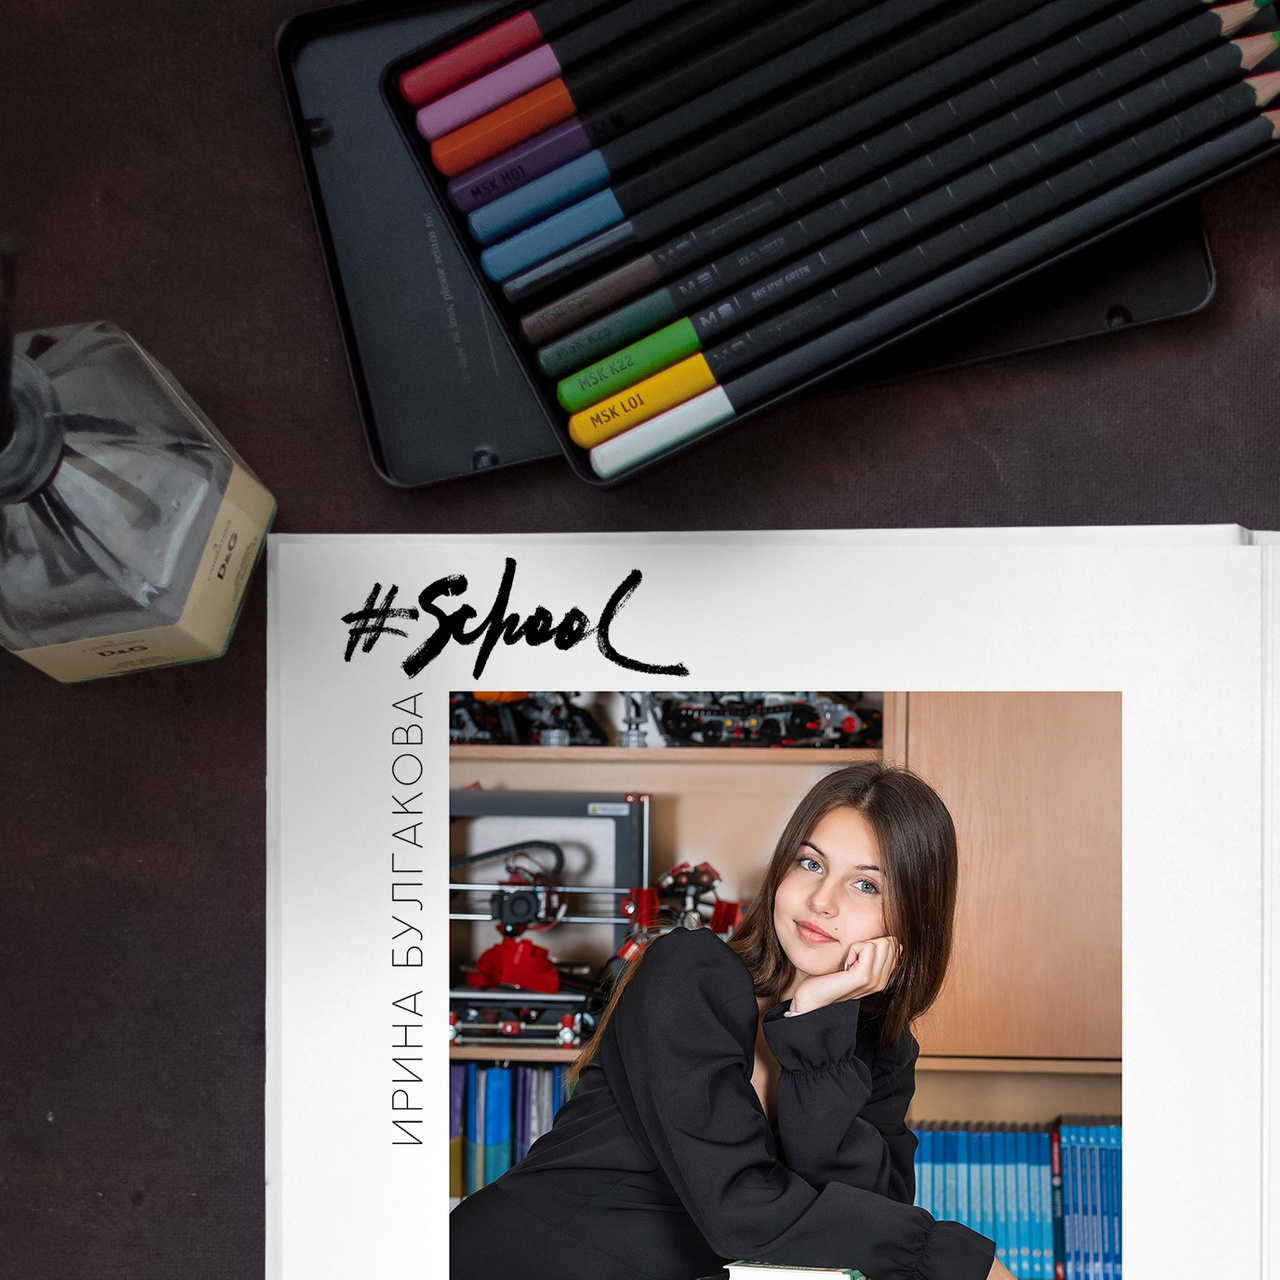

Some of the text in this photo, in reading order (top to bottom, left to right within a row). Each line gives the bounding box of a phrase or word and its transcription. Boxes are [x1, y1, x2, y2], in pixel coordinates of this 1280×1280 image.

[470, 177, 500, 201] MSK
[429, 231, 442, 263] return
[437, 268, 453, 301] please
[784, 264, 812, 285] GREEN
[578, 354, 635, 391] MSK K22
[590, 393, 645, 429] MSK L01
[216, 532, 239, 580] D&G
[97, 646, 150, 656] D&G
[391, 691, 424, 1145] ИРИНА БУЛГАКОВА
